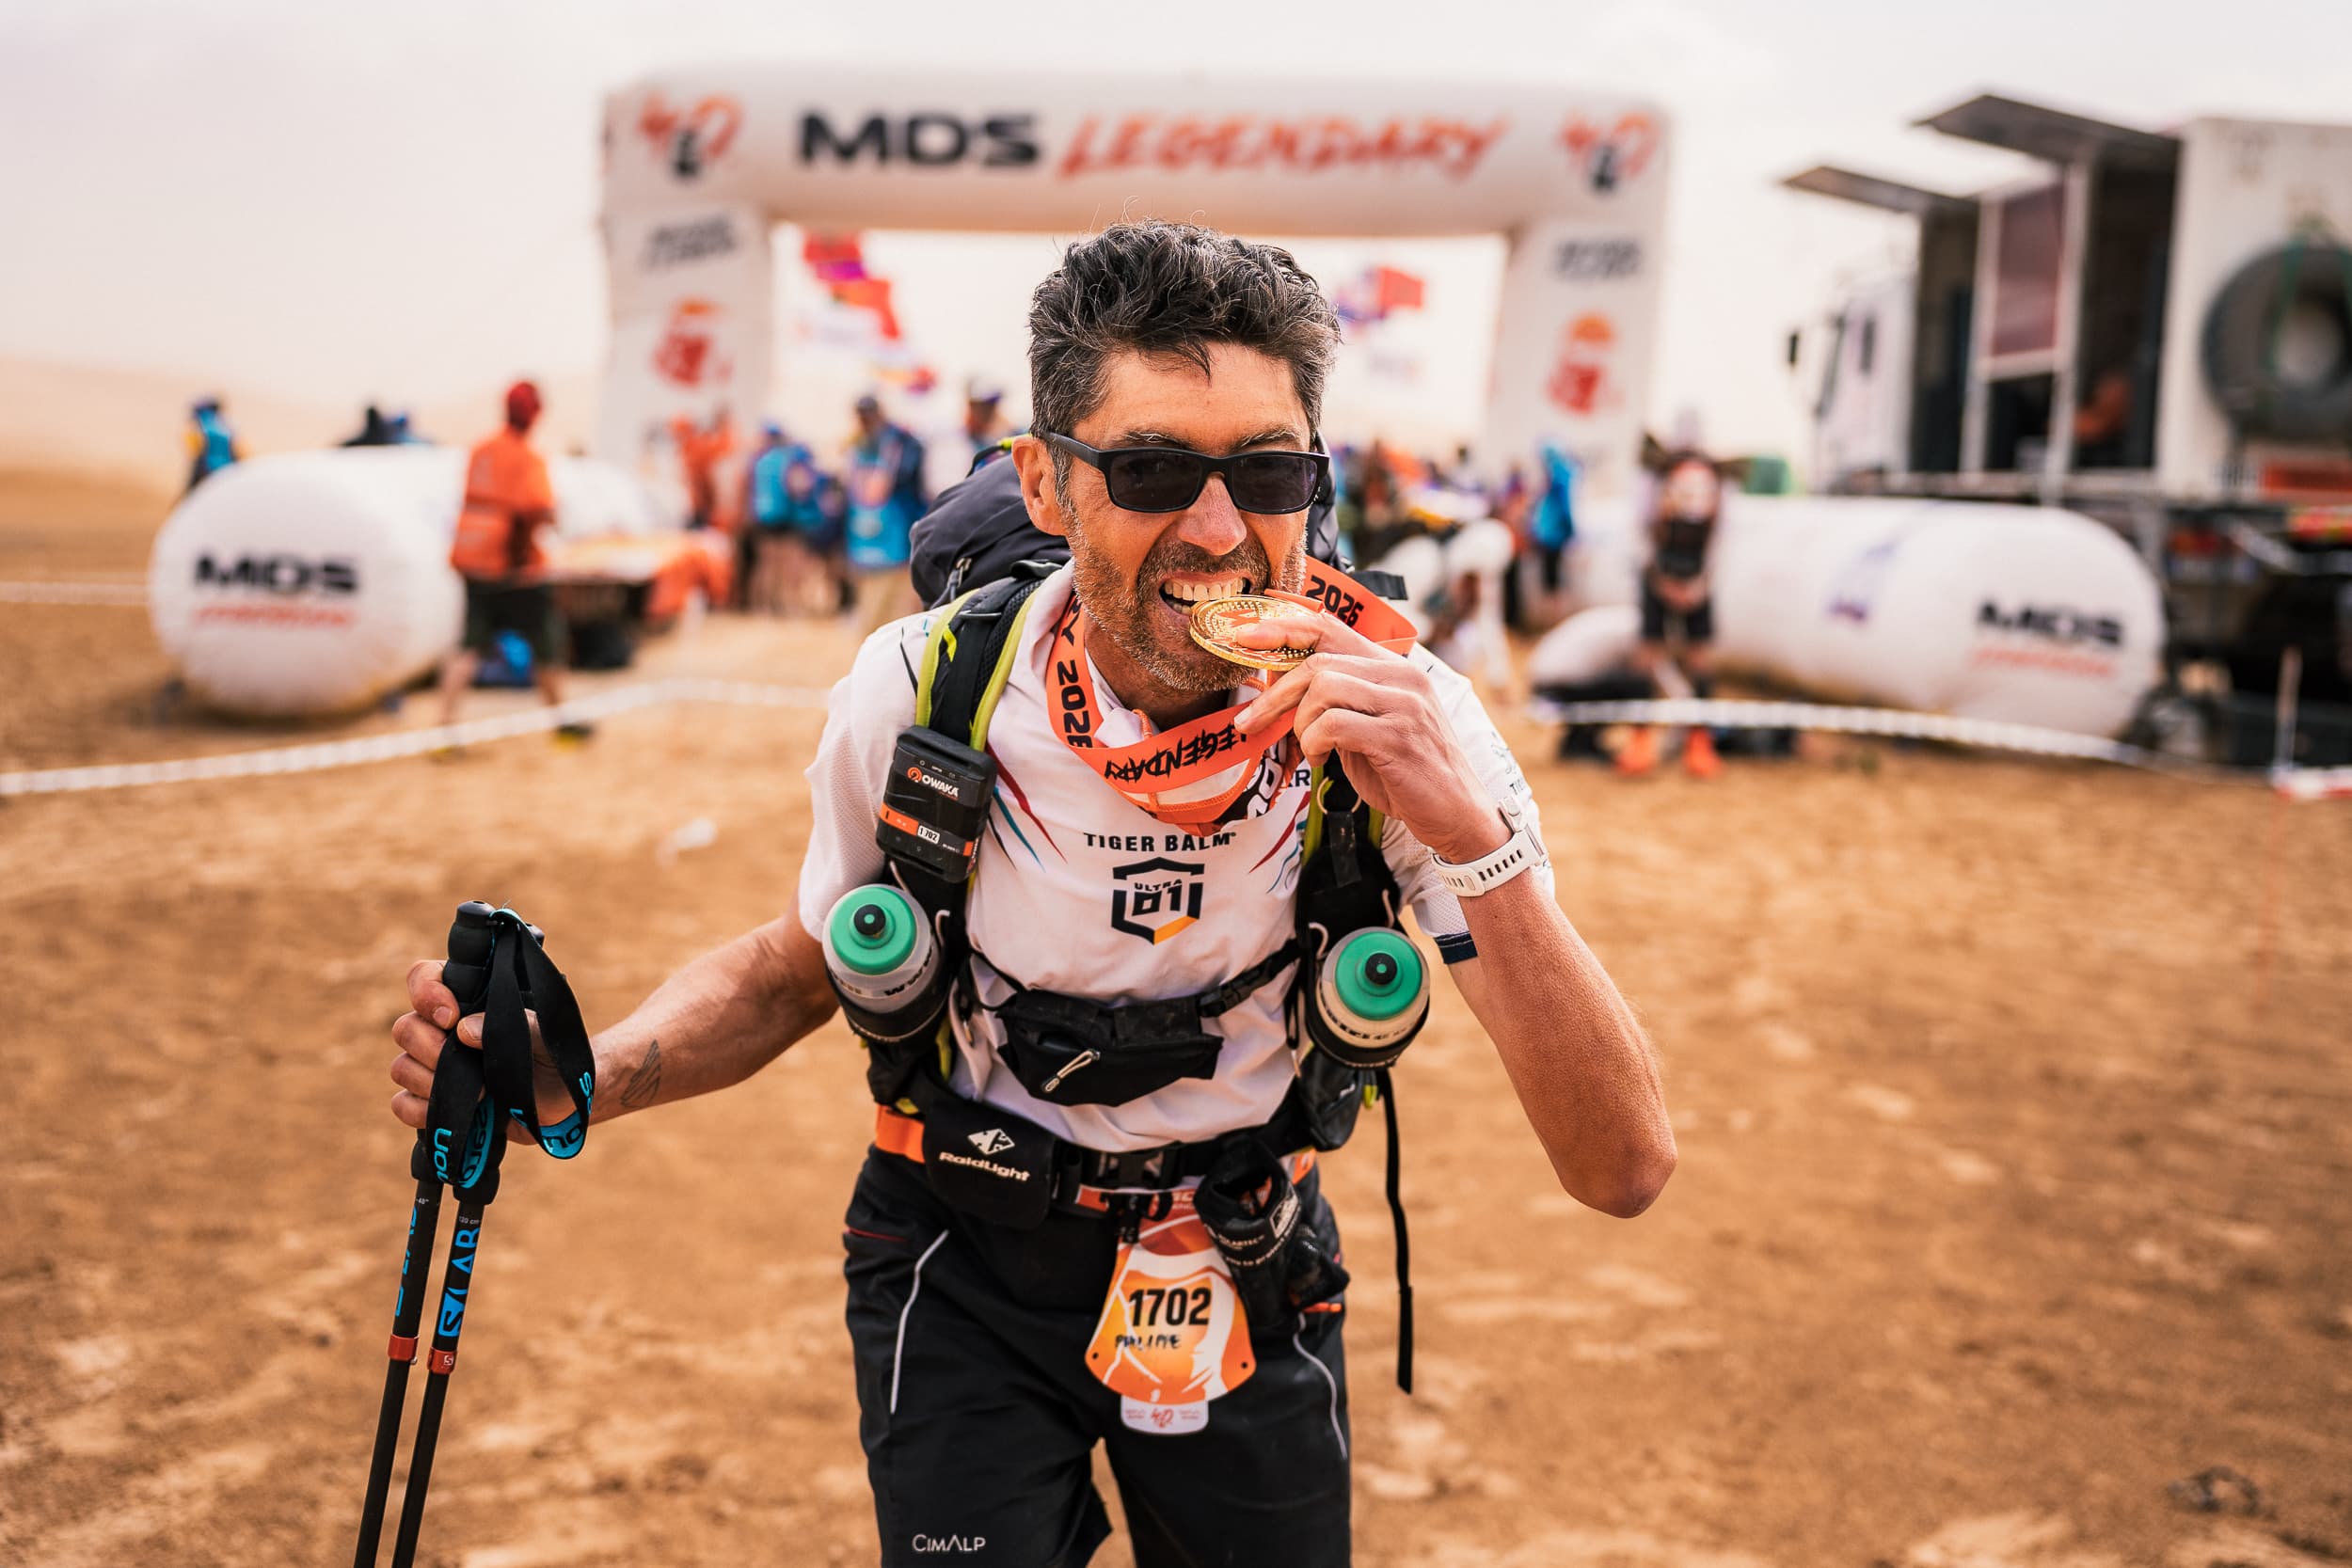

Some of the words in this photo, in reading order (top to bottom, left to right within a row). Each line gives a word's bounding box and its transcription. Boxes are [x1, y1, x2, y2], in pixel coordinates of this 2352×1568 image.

[798, 111, 1042, 166] MDS
[1057, 115, 1507, 179] LEGENDARY
[195, 553, 360, 596] MDS
[1306, 575, 1364, 627] 2026
[1977, 600, 2124, 647] MDS
[1104, 721, 1247, 783] EGENDARY
[922, 776, 960, 798] OWAKA
[1083, 832, 1154, 852] TIGER
[1134, 879, 1183, 892] ULTRA
[1129, 1287, 1212, 1327] 1702
